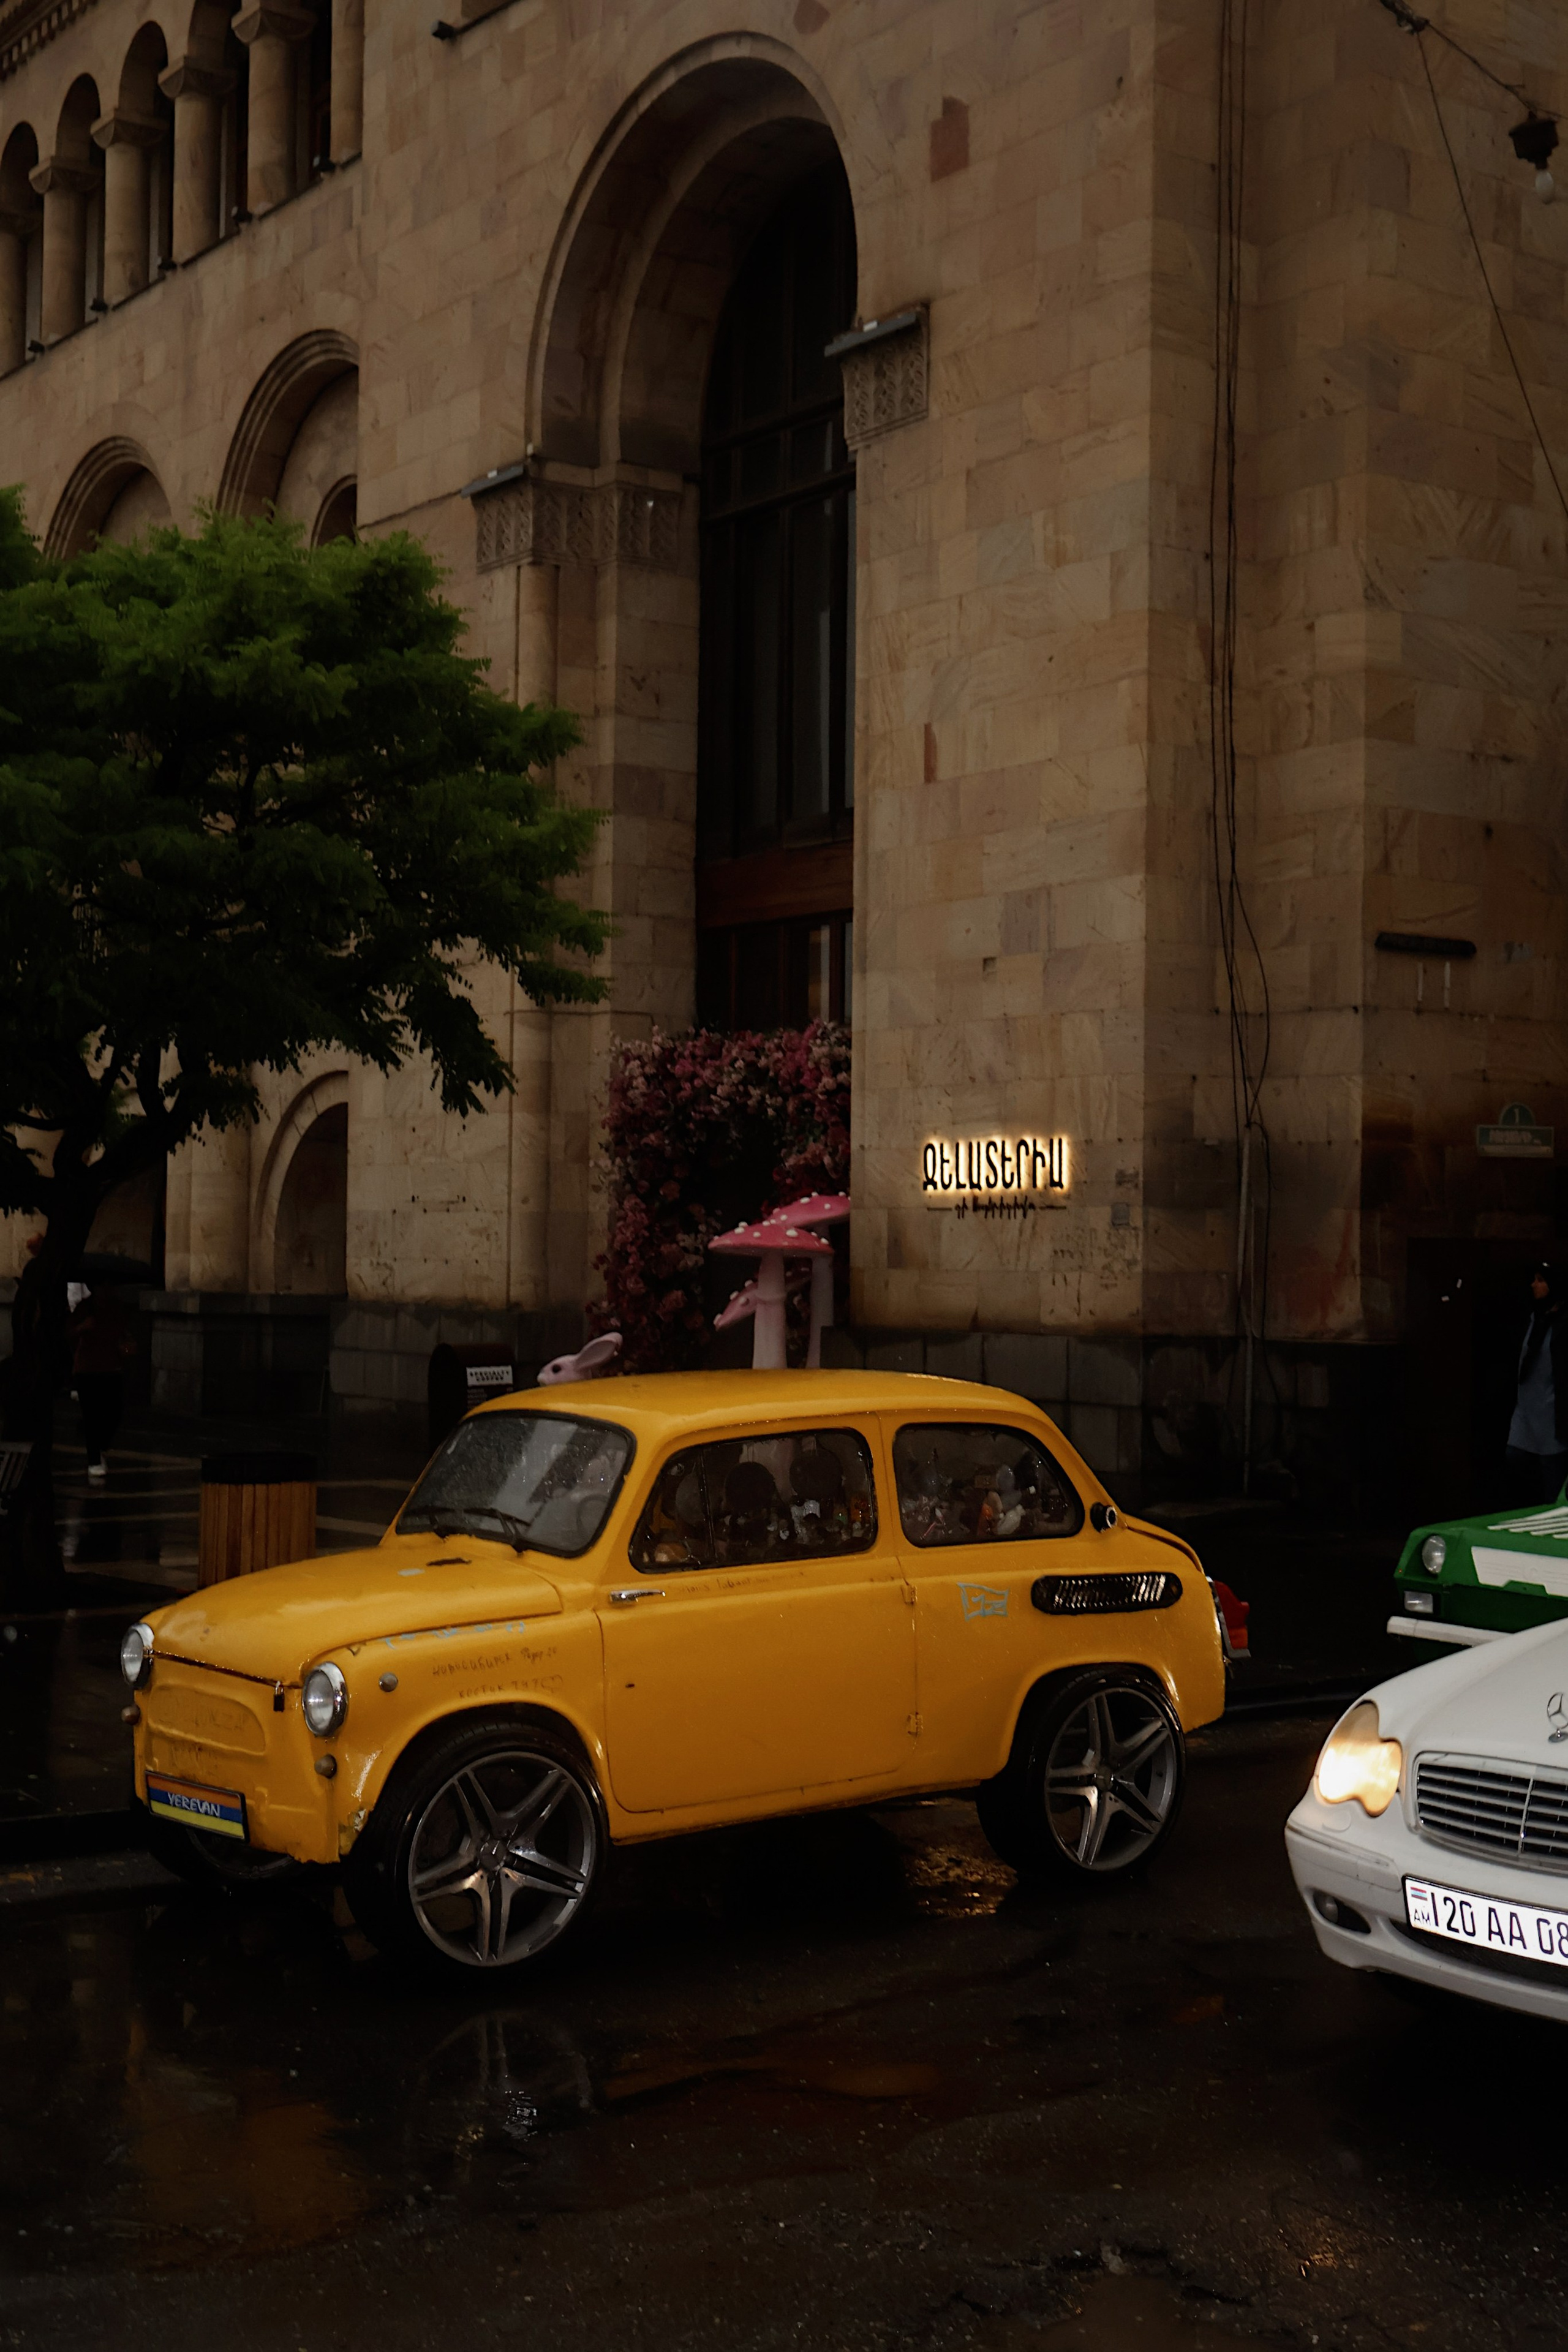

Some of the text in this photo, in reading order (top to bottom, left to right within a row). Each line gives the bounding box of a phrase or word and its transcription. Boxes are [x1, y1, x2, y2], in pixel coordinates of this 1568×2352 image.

[922, 1137, 1064, 1191] ՋԵԼԱՏԵՐԻԱ
[167, 1792, 221, 1819] YEREVAN
[1414, 1908, 1431, 1926] AM
[1430, 1891, 1477, 1938] 120
[1488, 1906, 1528, 1950] AA
